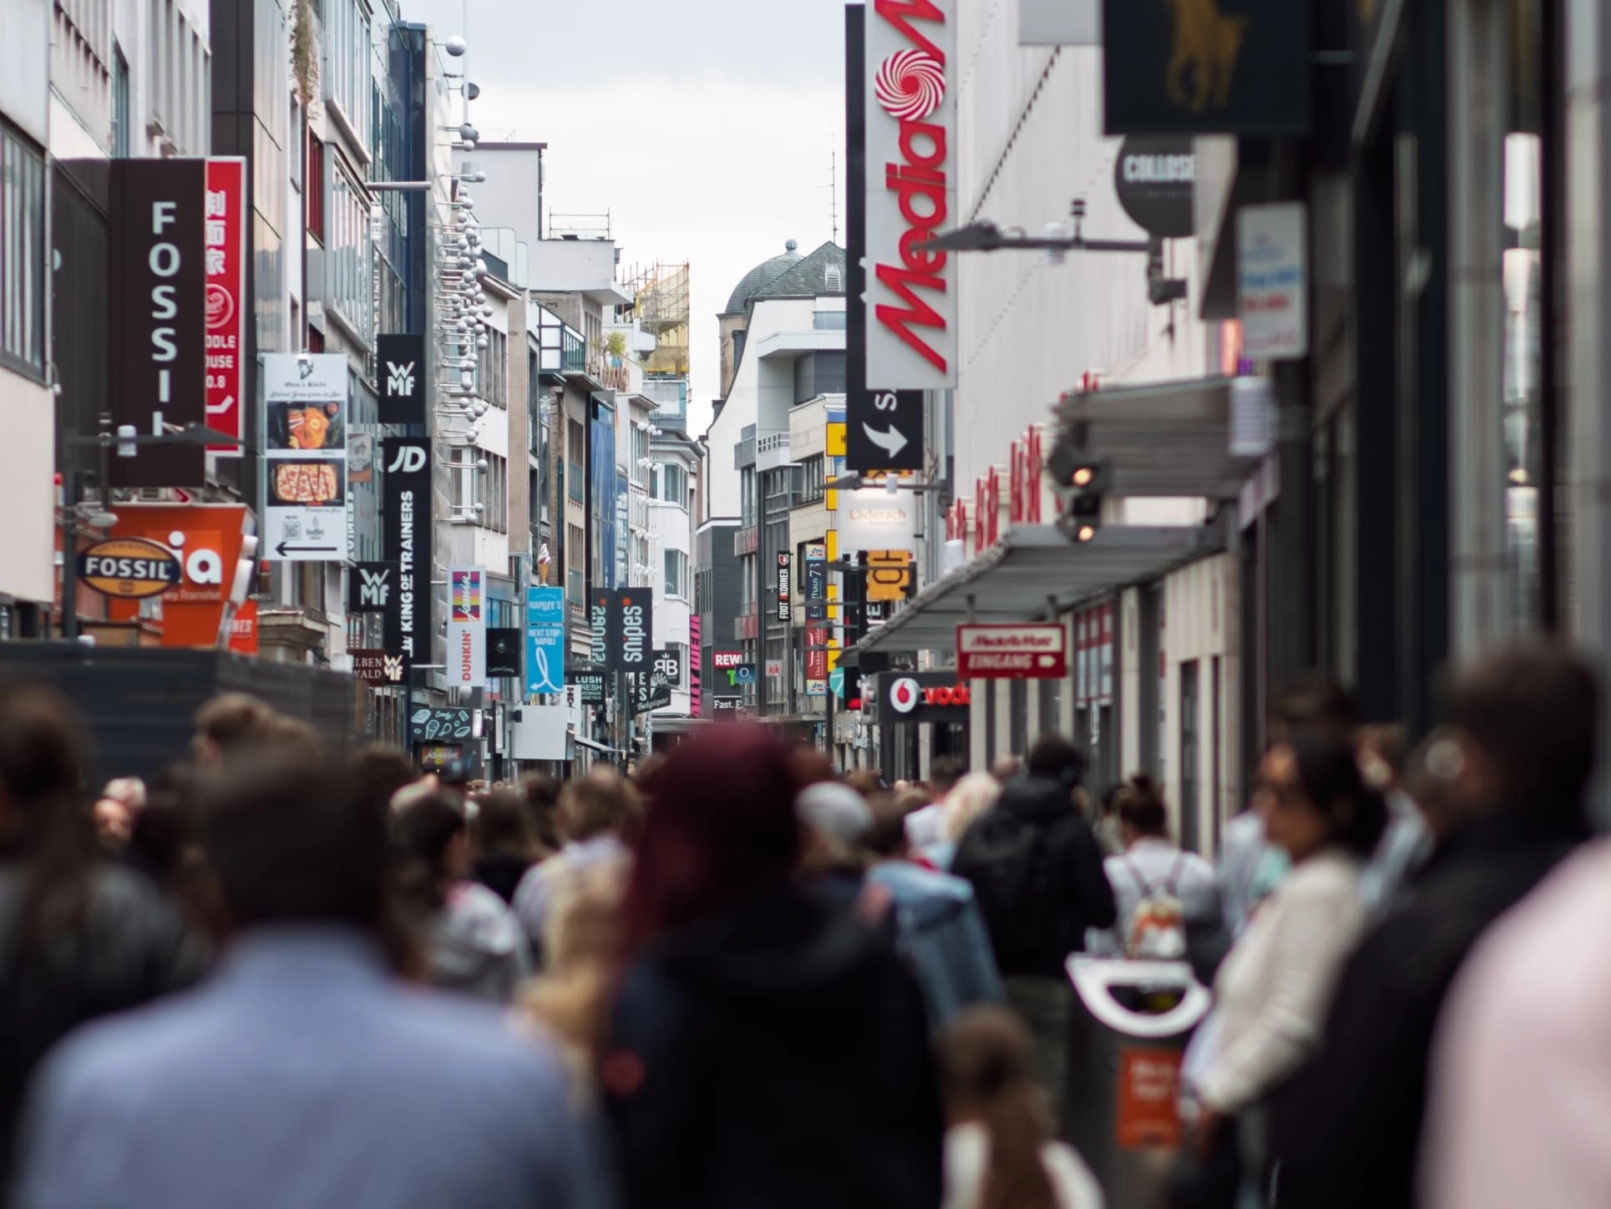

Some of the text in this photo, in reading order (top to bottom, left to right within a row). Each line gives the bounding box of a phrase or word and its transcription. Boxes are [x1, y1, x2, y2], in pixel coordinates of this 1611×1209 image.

[388, 446, 427, 473] JD
[85, 557, 170, 580] FOSSIL
[167, 530, 222, 584] ia
[401, 490, 413, 632] KING OF TRAINERS
[779, 569, 789, 619] FOOT KORNER
[623, 605, 647, 662] snipes
[354, 658, 382, 667] LBEN
[462, 629, 472, 681] DUNKIN'
[575, 676, 603, 684] LUSH
[768, 665, 781, 675] kik
[714, 701, 734, 709] Fast.
